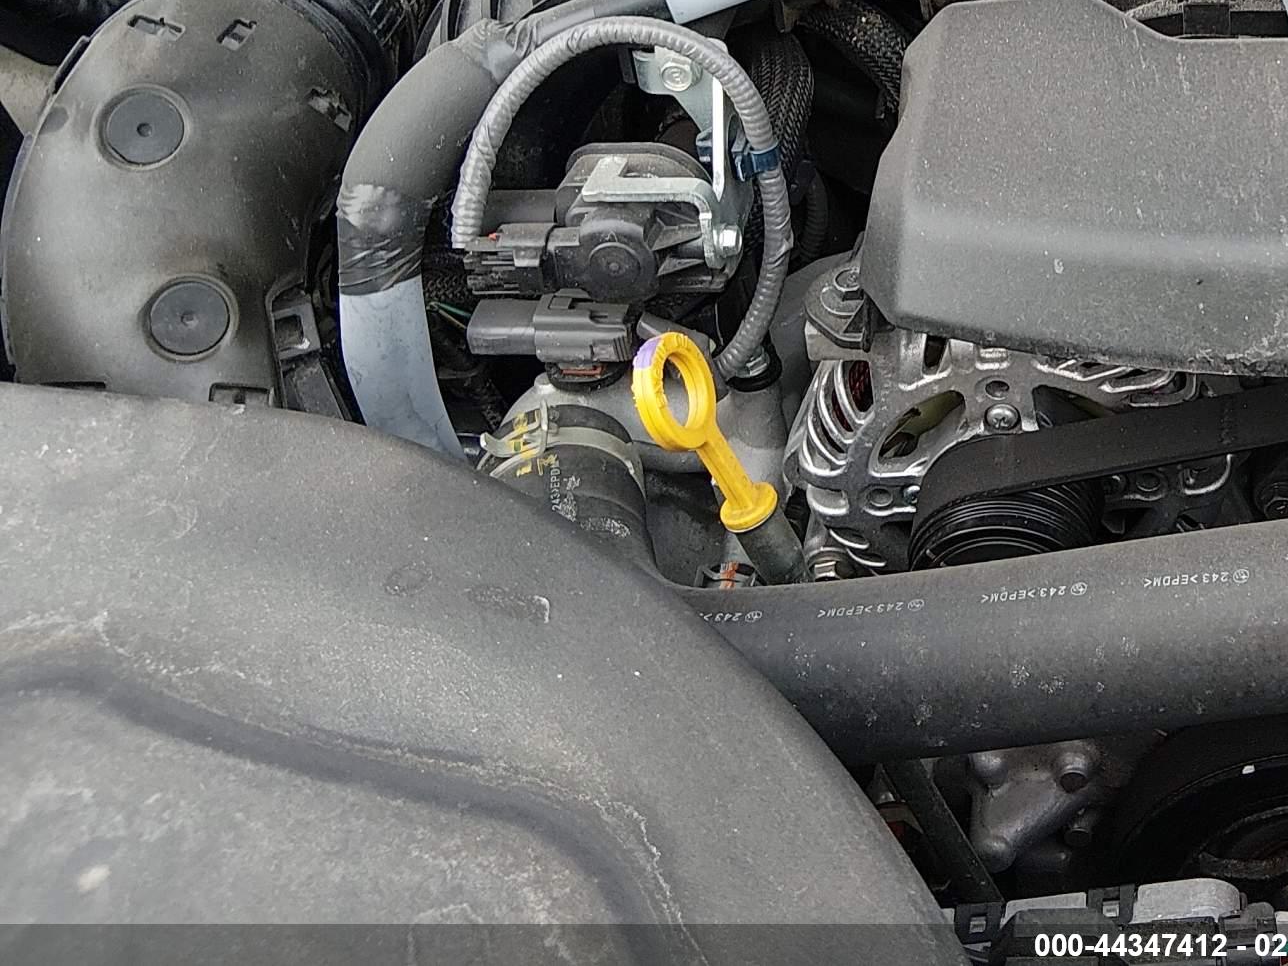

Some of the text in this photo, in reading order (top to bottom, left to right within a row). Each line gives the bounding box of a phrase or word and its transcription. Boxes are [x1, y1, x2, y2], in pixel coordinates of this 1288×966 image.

[1202, 571, 1229, 584] 243
[1040, 585, 1067, 598] 243
[877, 601, 904, 614] 243
